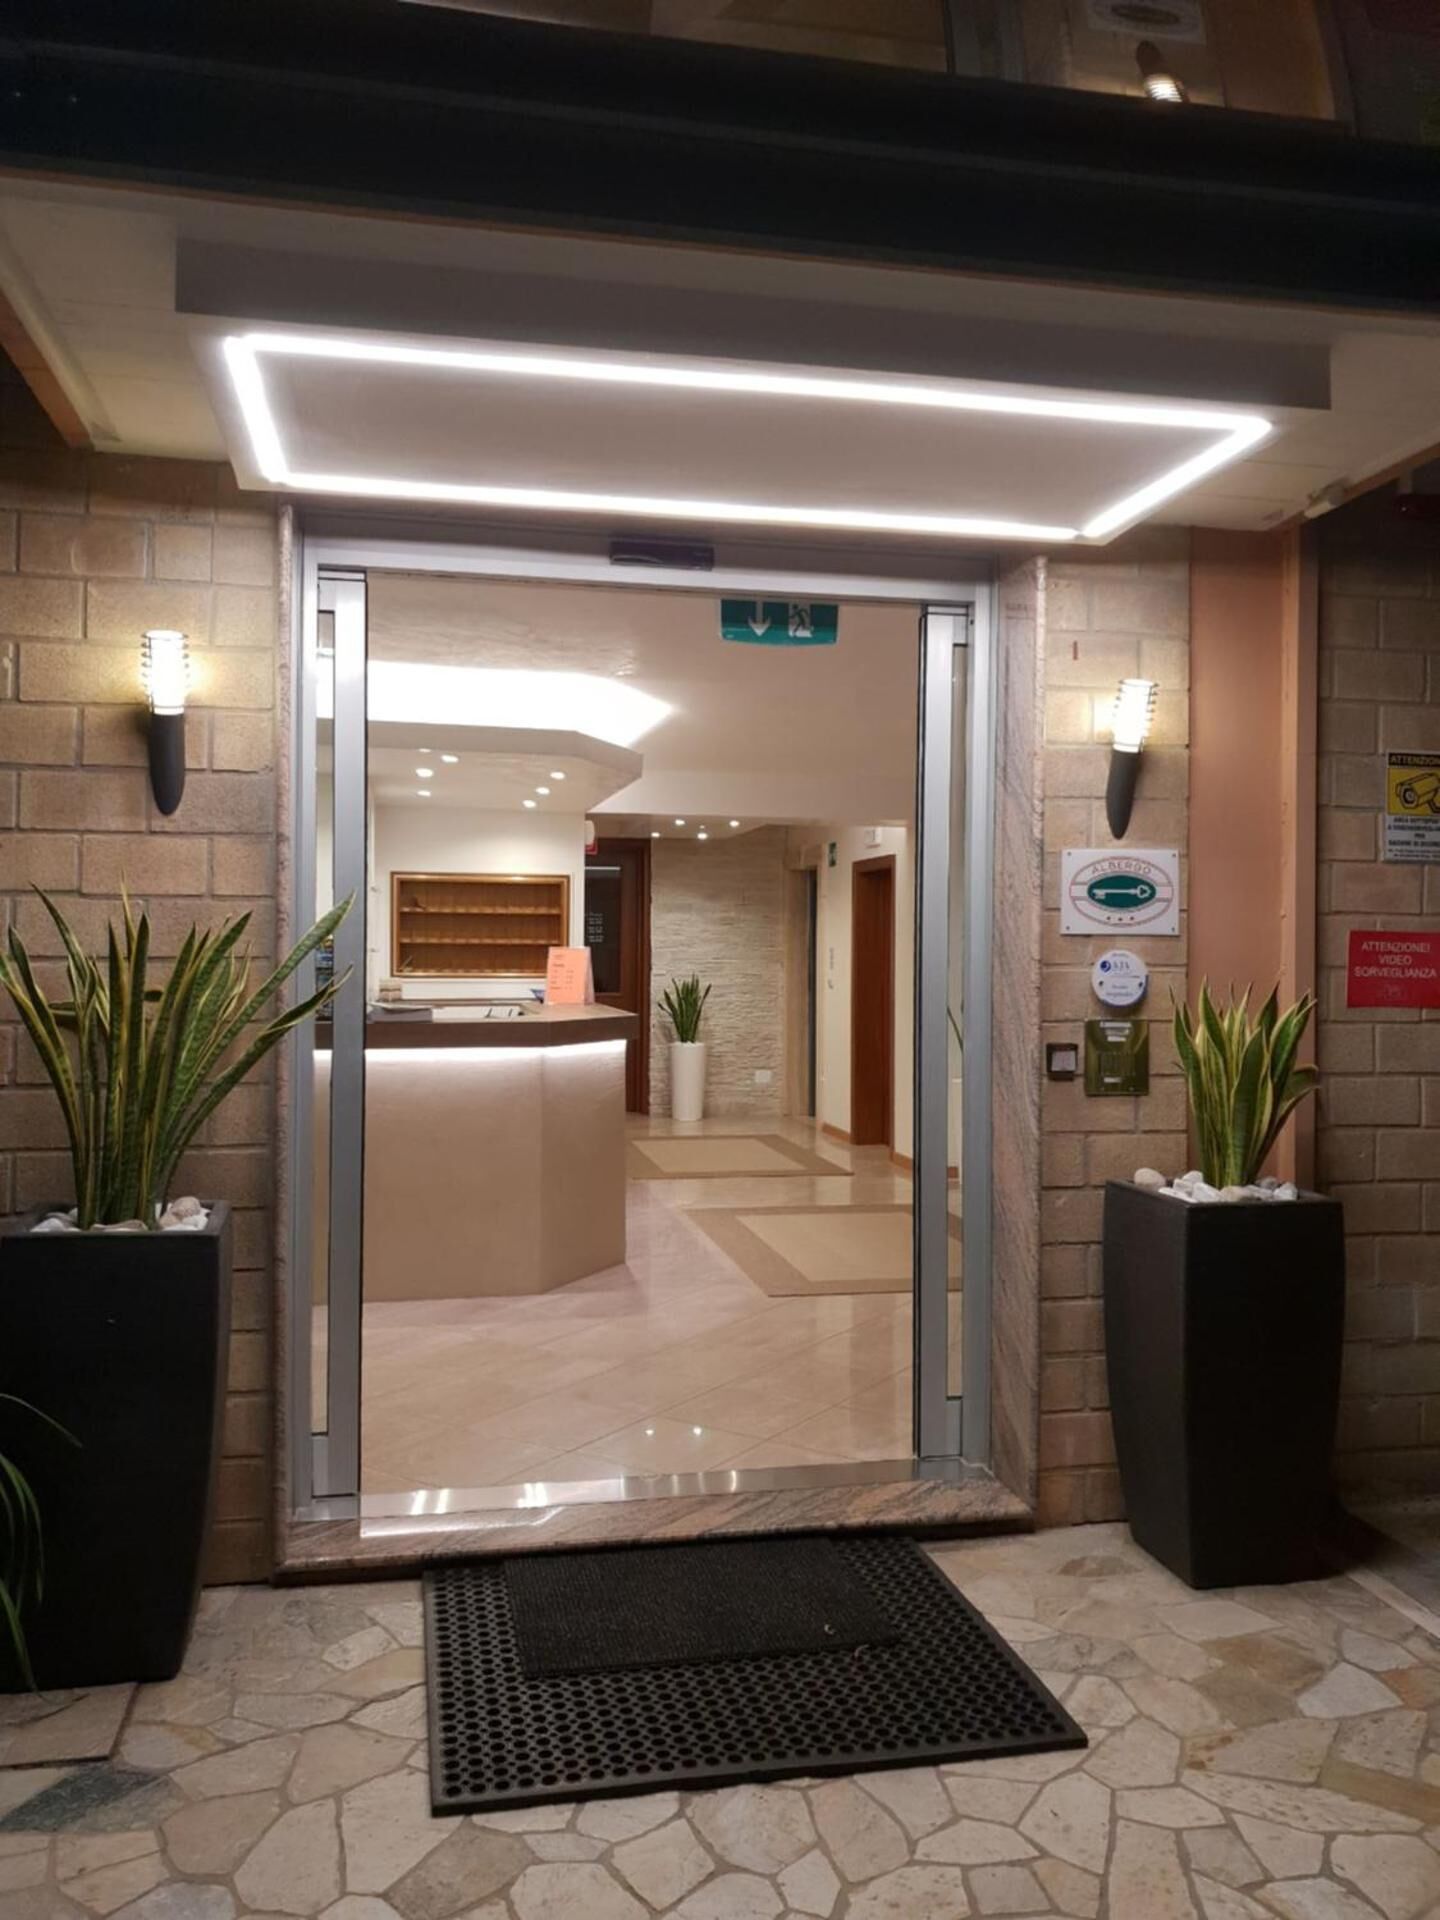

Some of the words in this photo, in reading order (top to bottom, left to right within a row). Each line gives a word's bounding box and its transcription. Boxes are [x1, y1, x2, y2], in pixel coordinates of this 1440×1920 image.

[1091, 861, 1151, 875] ALBERGO
[1378, 954, 1412, 965] VIDEO
[1354, 966, 1437, 978] SORVEGLIANZA
